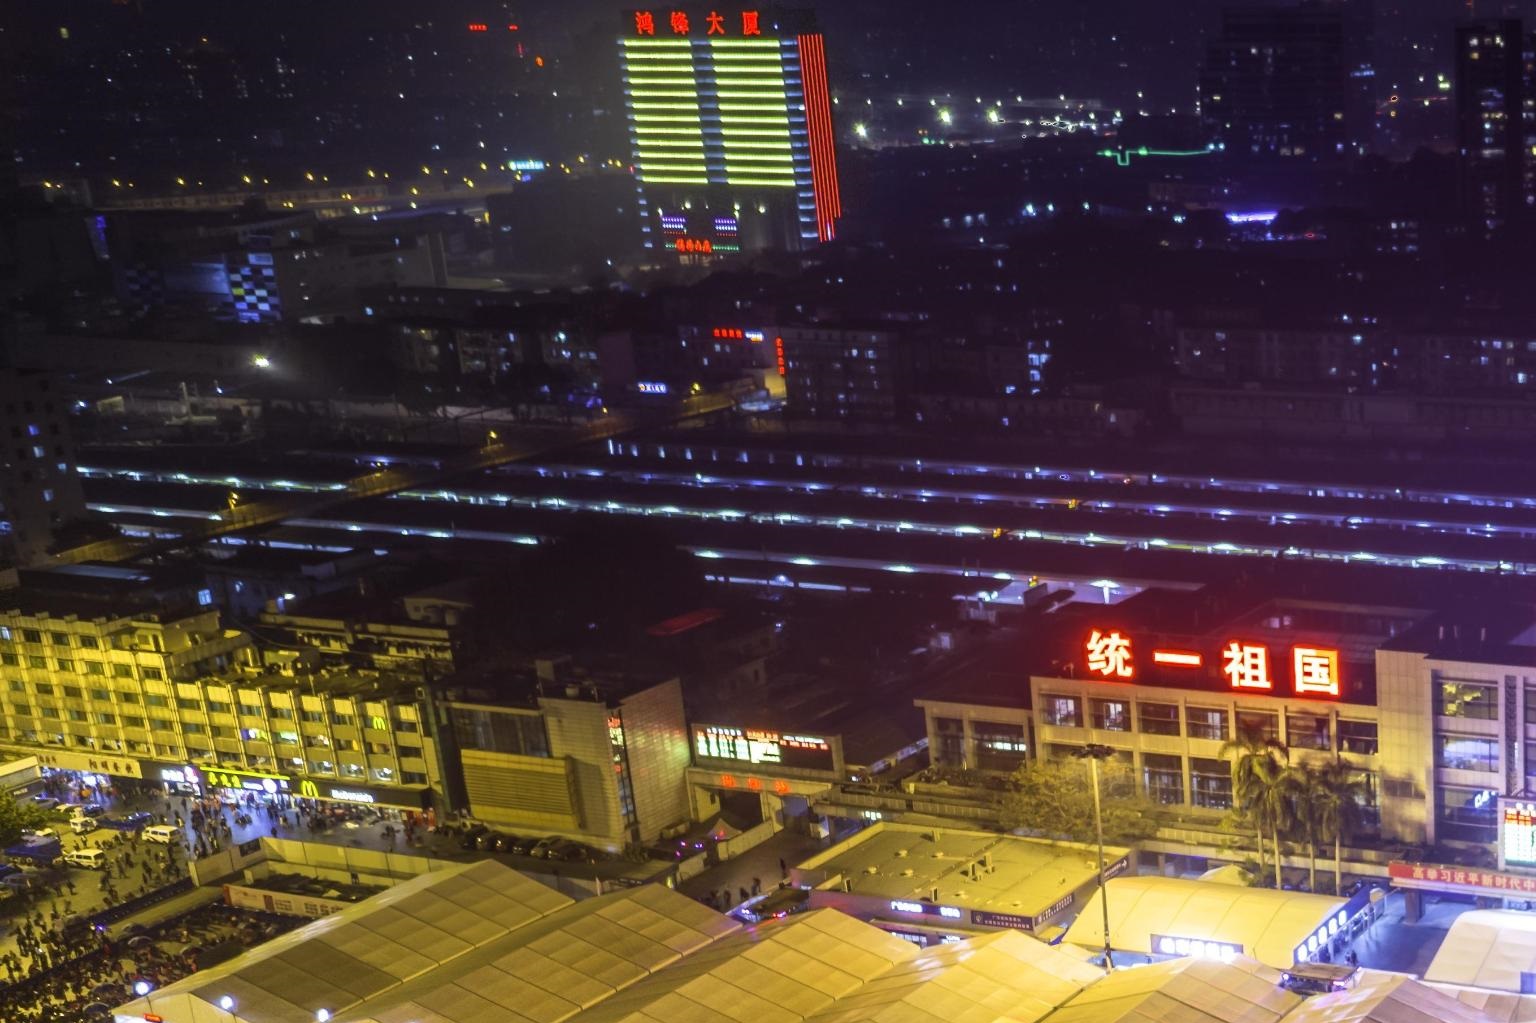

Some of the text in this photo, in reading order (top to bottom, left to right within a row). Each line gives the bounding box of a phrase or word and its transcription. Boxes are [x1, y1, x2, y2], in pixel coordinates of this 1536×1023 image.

[635, 11, 761, 35] 鸿锋大厦
[1087, 630, 1340, 696] 统一祖国
